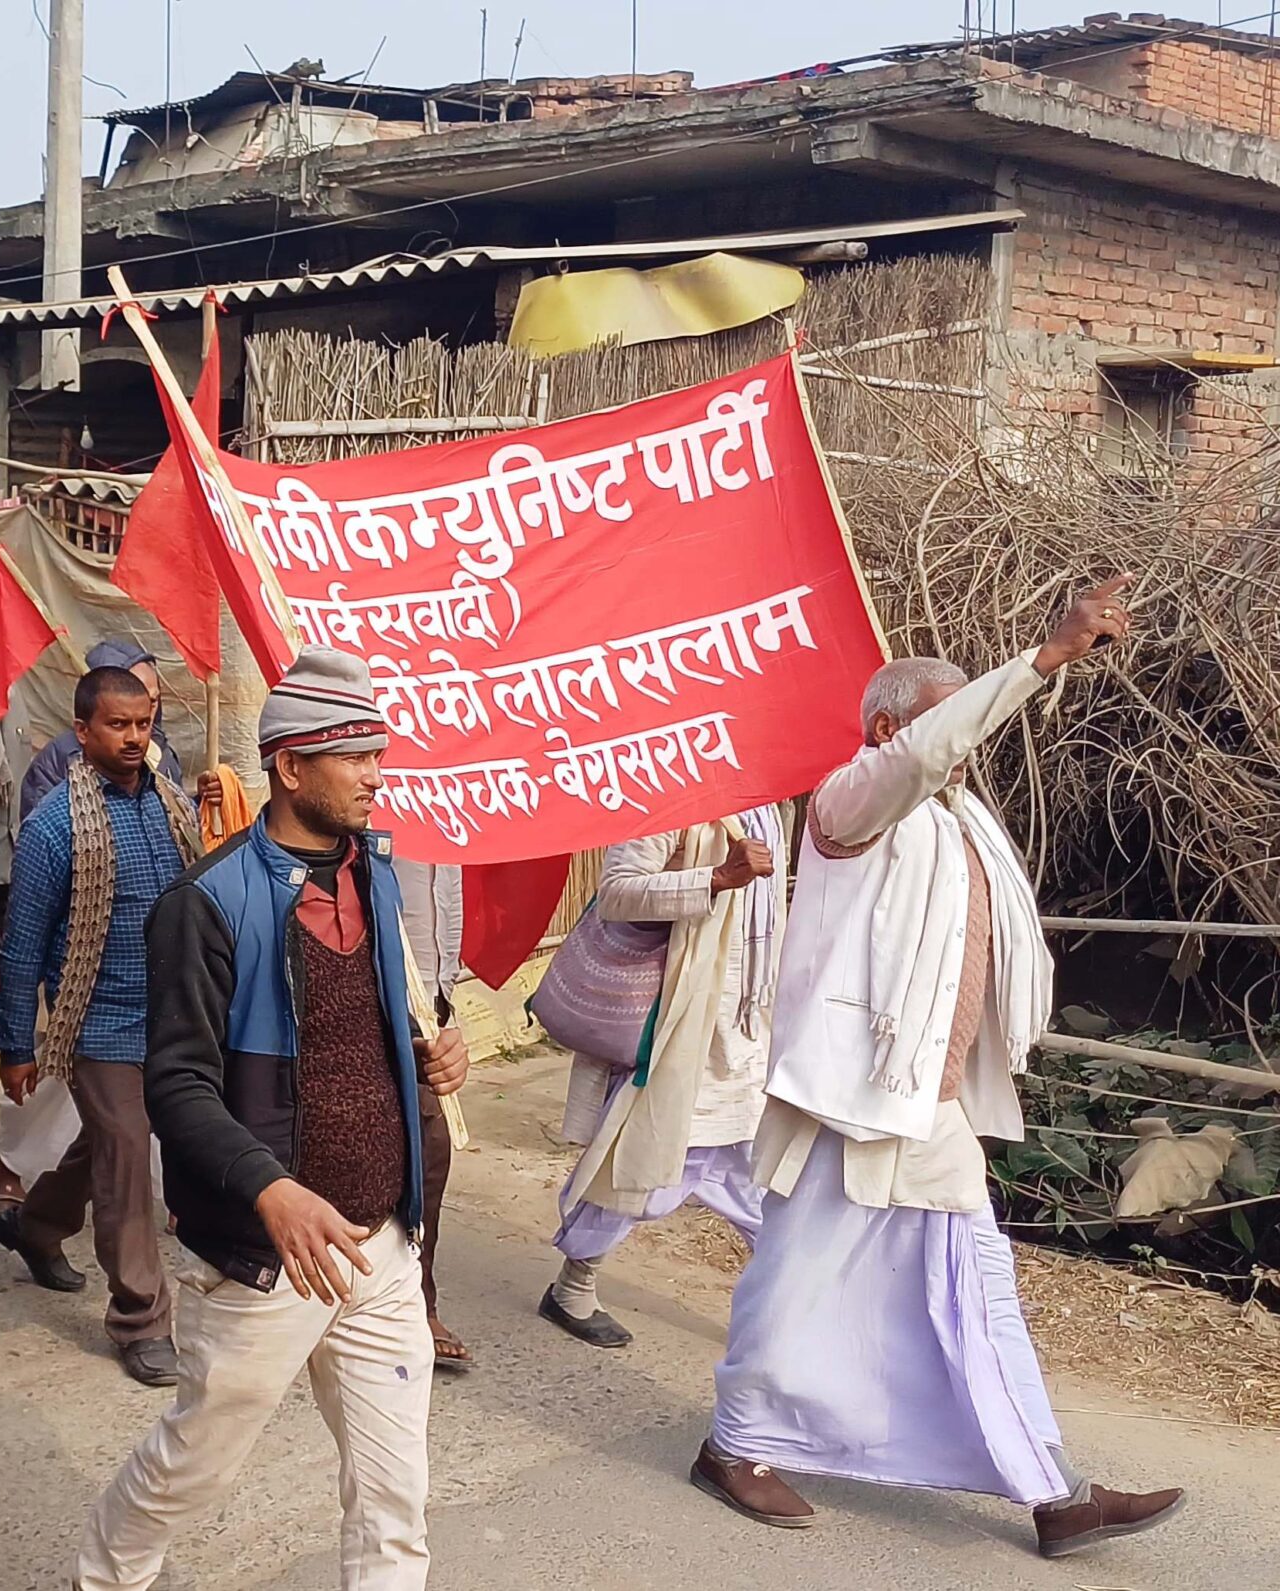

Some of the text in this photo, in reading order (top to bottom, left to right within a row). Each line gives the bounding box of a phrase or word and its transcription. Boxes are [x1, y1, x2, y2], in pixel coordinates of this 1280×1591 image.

[335, 443, 634, 578] कम्युनिष्ट
[636, 378, 776, 504] पार्टी
[482, 644, 621, 728] लाल
[606, 585, 819, 705] सलाम
